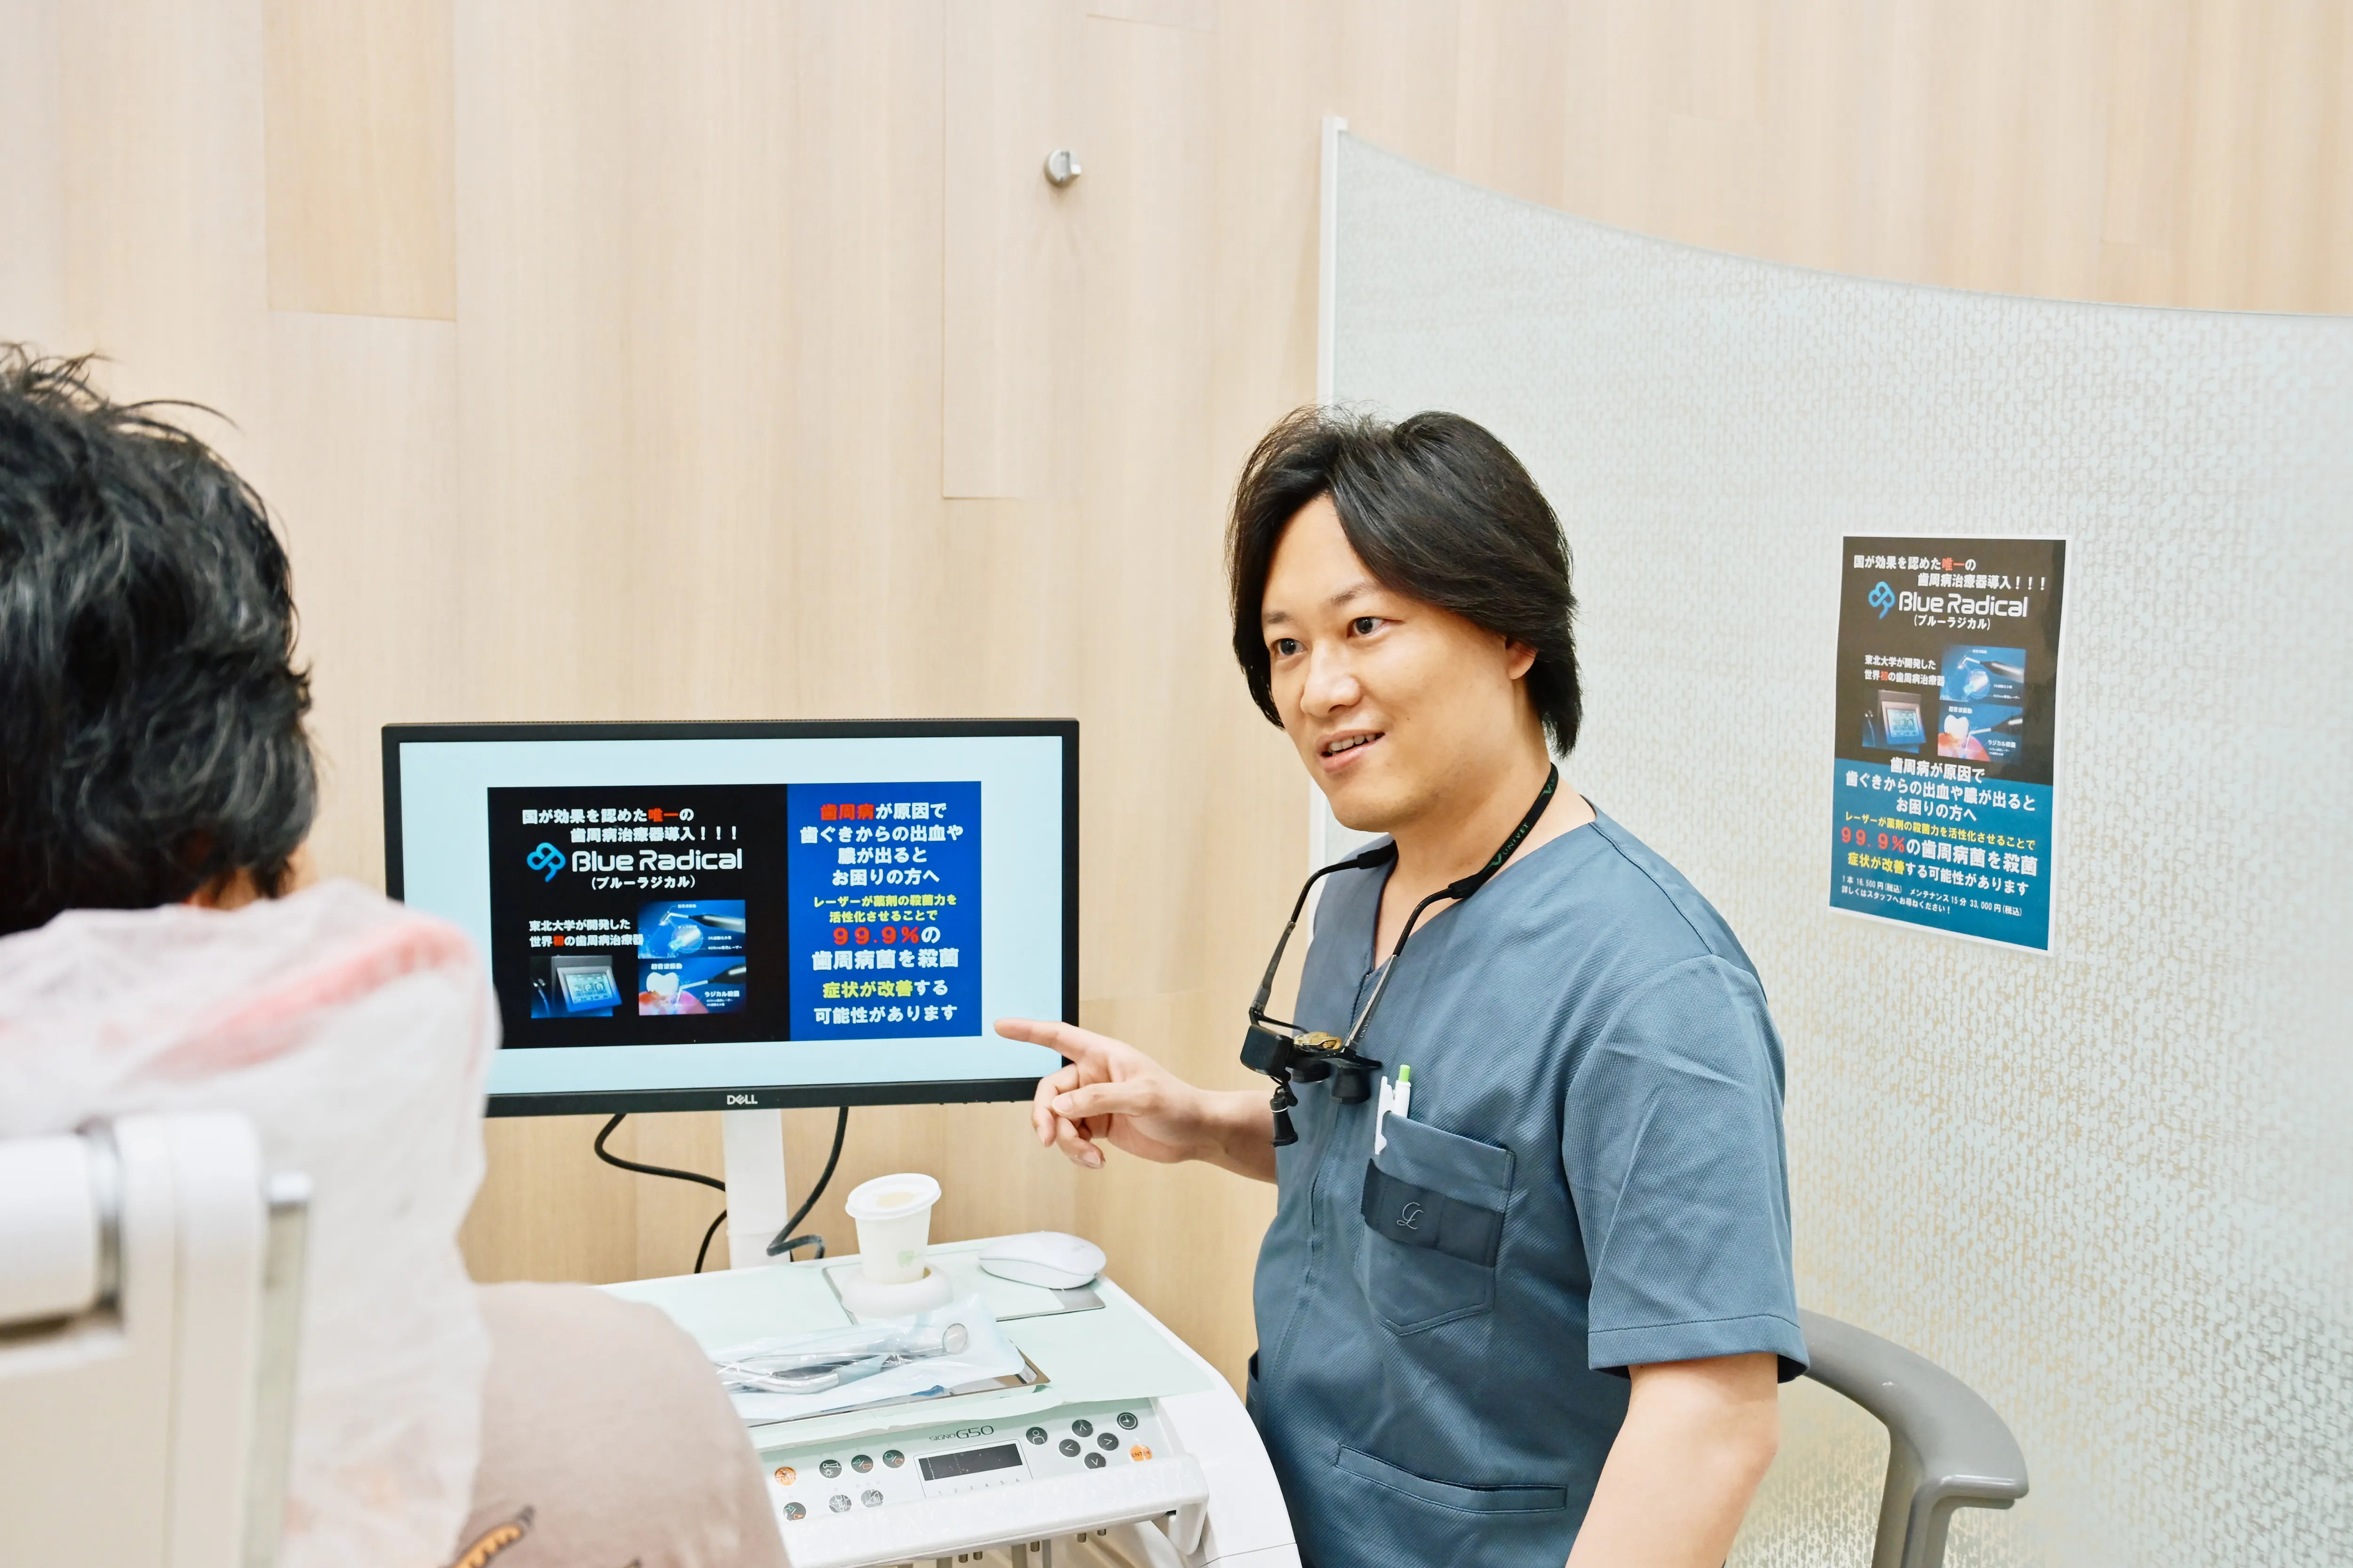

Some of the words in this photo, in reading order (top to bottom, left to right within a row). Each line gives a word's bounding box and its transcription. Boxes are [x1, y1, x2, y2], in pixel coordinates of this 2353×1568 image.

[1854, 555, 1976, 572] 国が効果を認めた唯一の
[1899, 591, 1944, 613] Blue
[1947, 593, 2028, 617] Radical
[1914, 614, 1991, 631] (ブルーラジカル)
[1865, 654, 1936, 670] 東北大学が開発した
[1864, 669, 1945, 688] 世界初の歯周病治療器
[1890, 756, 1985, 784] 歯周病が原因で
[1846, 770, 2035, 811] 歯ぐきからの出血や膿が出ると
[522, 808, 694, 824] 国が効果を認めた唯一の
[820, 802, 947, 821] 歯周病が原因で
[1896, 797, 1977, 822] お困りの方へ
[800, 824, 963, 844] 歯ぐきからの出血や
[1845, 811, 2035, 851] レーザーが薬剤の殺菌力を活性化させることで
[572, 851, 634, 872] Blue
[639, 848, 742, 871] Radical
[838, 847, 927, 865] 膿が出ると
[592, 875, 696, 890] (ブルーラジカル)
[832, 868, 940, 886] お困りの方へ
[1848, 852, 2029, 896] 症状が改善する可能性があります
[814, 894, 957, 908] レーザーが薬剤の殺菌力を
[529, 919, 630, 932] 東北大学が開発した
[830, 909, 938, 923] 活性化させることで
[529, 934, 644, 947] 世界初の歯周病治療器
[812, 947, 959, 971] 歯周病菌を殺菌
[823, 979, 948, 999] 症状が改善する
[814, 1005, 958, 1024] 可能性があります
[727, 1094, 758, 1105] DELL
